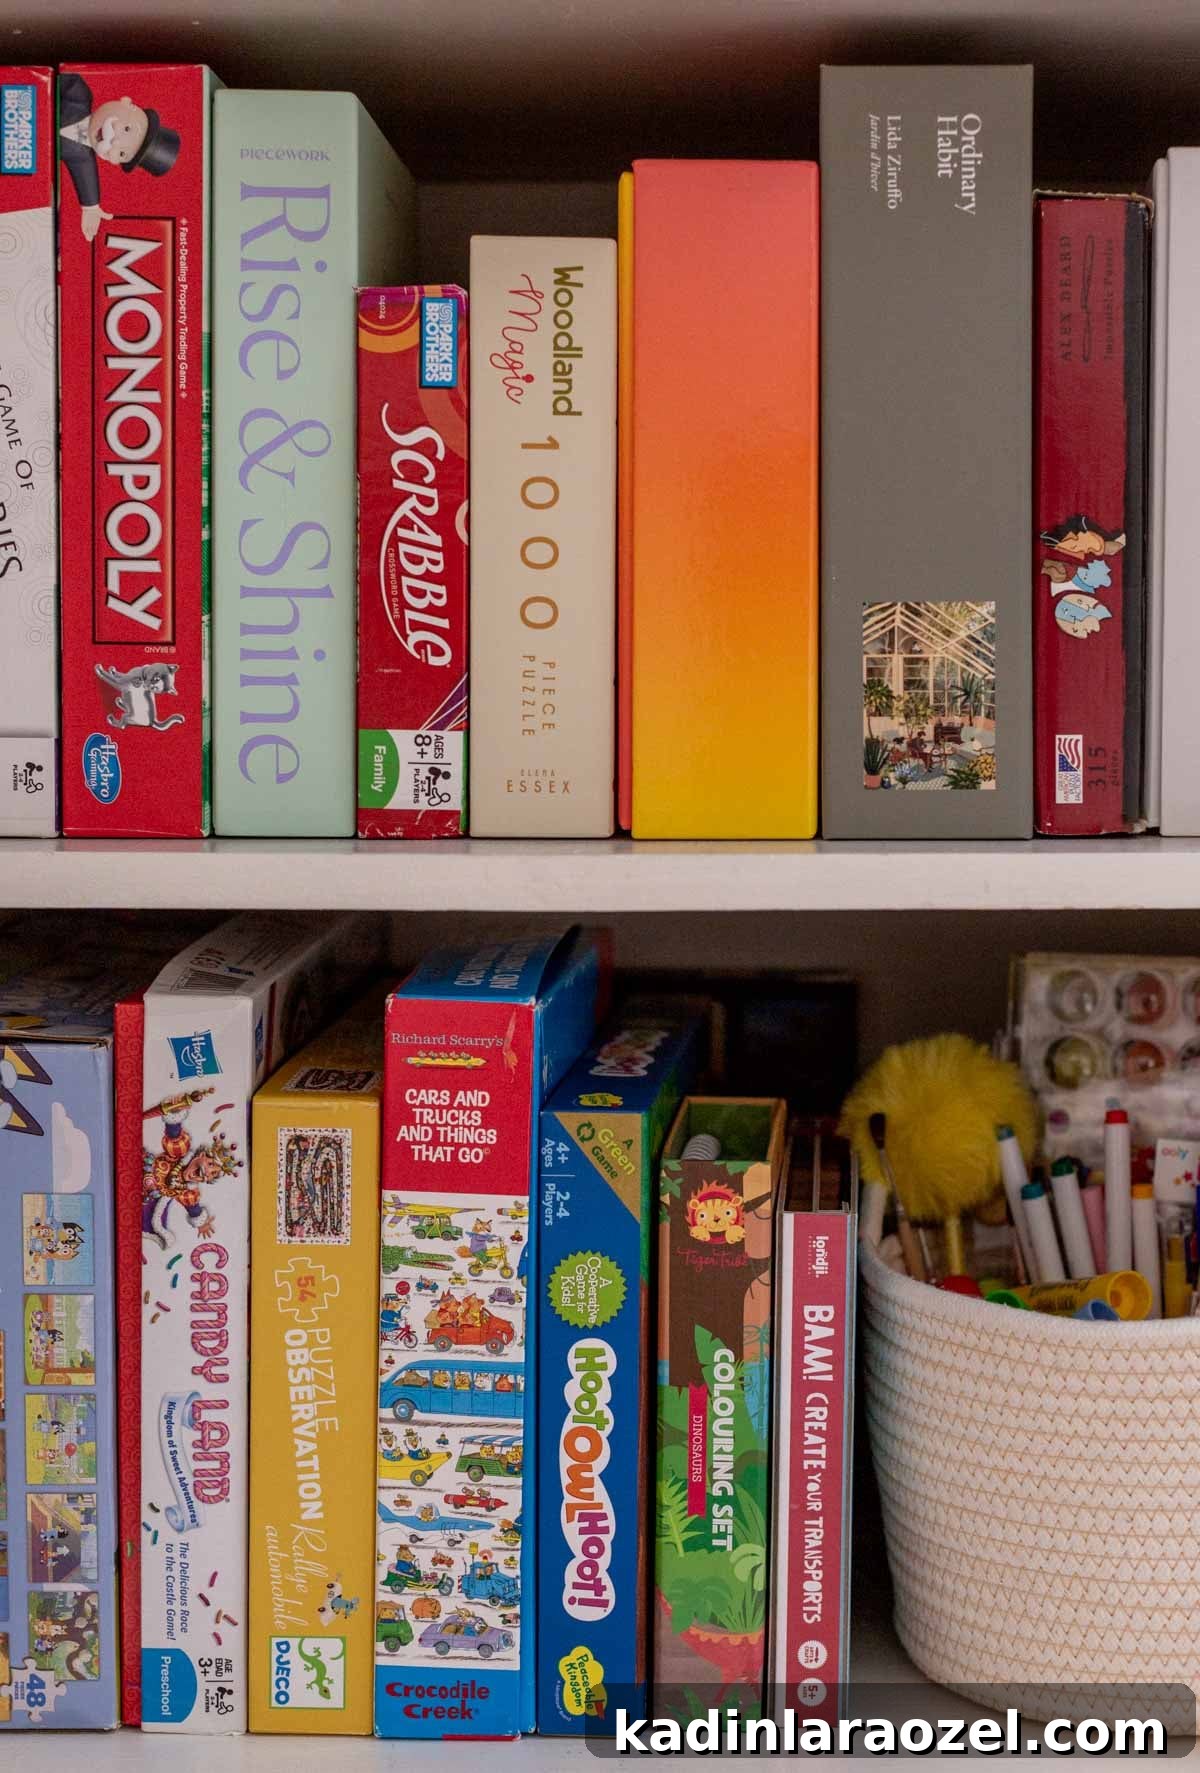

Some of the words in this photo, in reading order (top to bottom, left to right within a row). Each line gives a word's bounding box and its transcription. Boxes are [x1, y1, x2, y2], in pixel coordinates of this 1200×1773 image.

[5, 89, 19, 169] BROTHERS
[19, 111, 33, 169] PARKER
[887, 115, 902, 150] Lida
[937, 115, 960, 179] Habit
[887, 154, 903, 209] Ziruffo
[954, 113, 984, 216] Ordinary
[178, 227, 189, 282] Fast-Dealing
[238, 182, 331, 381] Rise
[178, 284, 189, 325] Property
[178, 327, 189, 361] Trading
[425, 302, 439, 383] BROTHERS
[439, 324, 454, 383] PARKER
[489, 273, 544, 404] Magic
[552, 265, 584, 416] Woodland
[1059, 310, 1073, 362] ALEX
[178, 363, 189, 390] Game
[104, 234, 163, 631] MONOPOLY
[238, 408, 331, 494] &
[15, 459, 35, 490] OF
[520, 434, 560, 630] 1000
[388, 548, 398, 596] CROSSWORD
[392, 597, 401, 620] GAME
[238, 518, 335, 785] Shine
[521, 654, 536, 736] PUZZLE
[542, 661, 556, 730] PIECE
[86, 747, 101, 788] Gaming
[98, 737, 116, 798] Hasbro
[414, 733, 432, 760] 8+
[434, 734, 444, 760] AGES
[370, 744, 387, 793] Family
[506, 780, 570, 793] ESSEX
[1087, 746, 1106, 791] 315
[189, 1030, 206, 1079] Hasbro
[391, 1033, 446, 1045] Richard
[449, 1034, 504, 1048] Scarry's
[405, 1089, 450, 1105] CARS
[453, 1089, 490, 1107] AND
[412, 1108, 482, 1126] TRUCKS
[396, 1124, 433, 1142] AND
[411, 1144, 455, 1162] THAT
[458, 1147, 484, 1163] GO
[541, 1137, 556, 1168] Ages
[556, 1142, 570, 1164] 4+
[598, 1128, 635, 1175] Green
[622, 1139, 634, 1150] A
[591, 1145, 619, 1179] Game
[542, 1183, 556, 1226] Players
[556, 1191, 570, 1218] 2-4
[296, 1274, 317, 1303] 54
[561, 1275, 576, 1306] Kids!
[575, 1264, 588, 1299] Game
[587, 1256, 602, 1324] Cooperative
[600, 1276, 613, 1288] A
[576, 1302, 587, 1314] for
[802, 1305, 835, 1382] BAM!
[306, 1327, 339, 1433] PUZZLE
[163, 1401, 177, 1438] Kingdom
[284, 1328, 324, 1521] OBSERVATION
[712, 1348, 736, 1497] COLOURING
[802, 1392, 829, 1470] CREATE
[167, 1440, 177, 1448] of
[169, 1448, 183, 1475] Sweet
[692, 1415, 703, 1482] DINOSAURS
[178, 1476, 198, 1524] Adventures
[165, 1543, 174, 1553] to
[711, 1503, 734, 1551] SET
[165, 1556, 176, 1572] the
[179, 1542, 190, 1559] The
[290, 1522, 329, 1593] Rallye
[802, 1516, 824, 1624] TRANSPORTS
[166, 1575, 177, 1606] Castle
[179, 1562, 190, 1607] Delicious
[265, 1524, 310, 1631] automobile
[166, 1609, 177, 1641] Game!
[180, 1609, 190, 1633] Race
[160, 1656, 172, 1716] Preschool
[198, 1657, 213, 1677] 3+
[215, 1657, 223, 1678] EDAD
[224, 1658, 233, 1673] AGE
[274, 1640, 291, 1705] DJECO
[565, 1662, 582, 1707] Kingdom
[576, 1653, 598, 1710] Peaceable
[26, 1673, 46, 1708] 48
[385, 1679, 490, 1701] Crocodile
[402, 1701, 474, 1720] Creek
[808, 1685, 818, 1700] 5+
